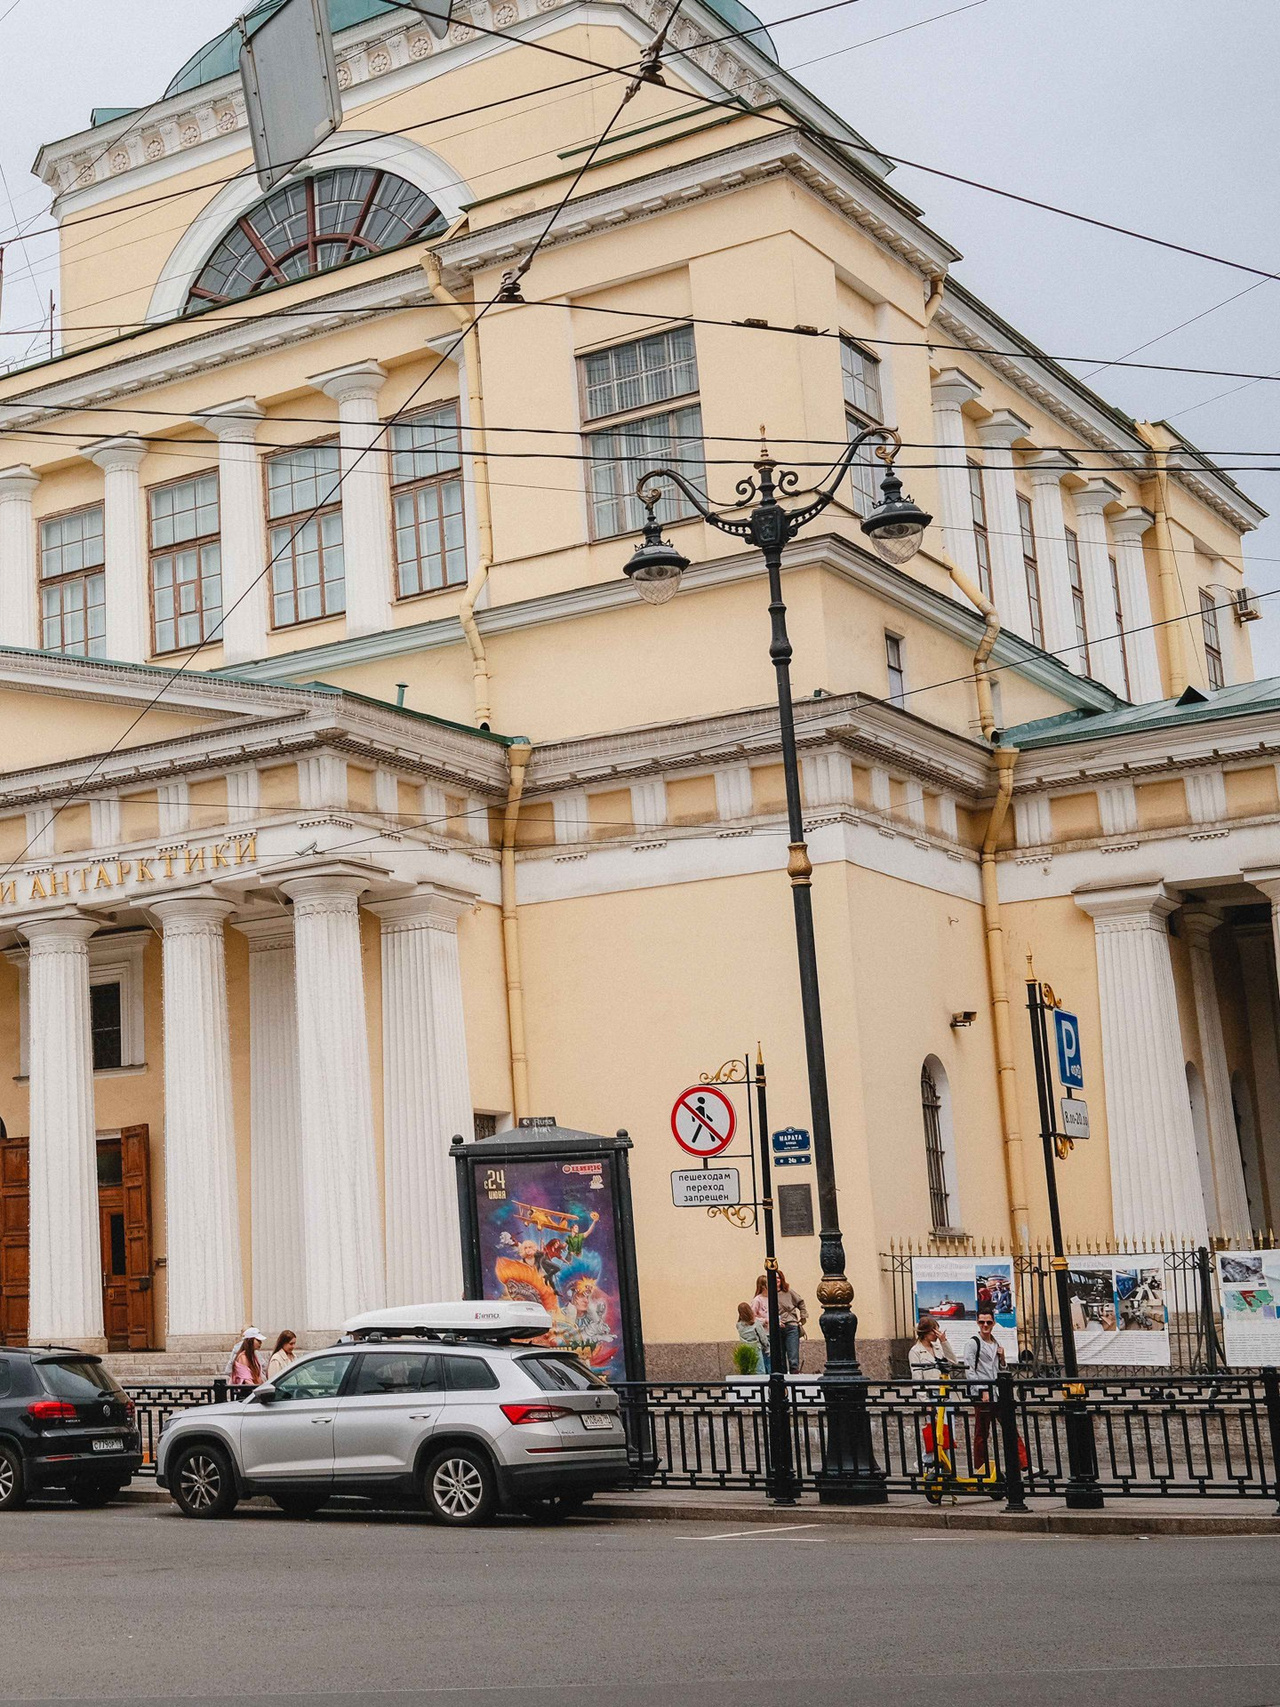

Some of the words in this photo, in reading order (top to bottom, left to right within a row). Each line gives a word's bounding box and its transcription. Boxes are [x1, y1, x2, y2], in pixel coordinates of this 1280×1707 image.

[29, 835, 258, 900] АНТАРКТИКИ
[1061, 1020, 1076, 1077] P
[487, 1169, 506, 1190] 24
[678, 1173, 731, 1182] пешеходам
[686, 1184, 725, 1193] переход
[683, 1194, 729, 1203] запрещен
